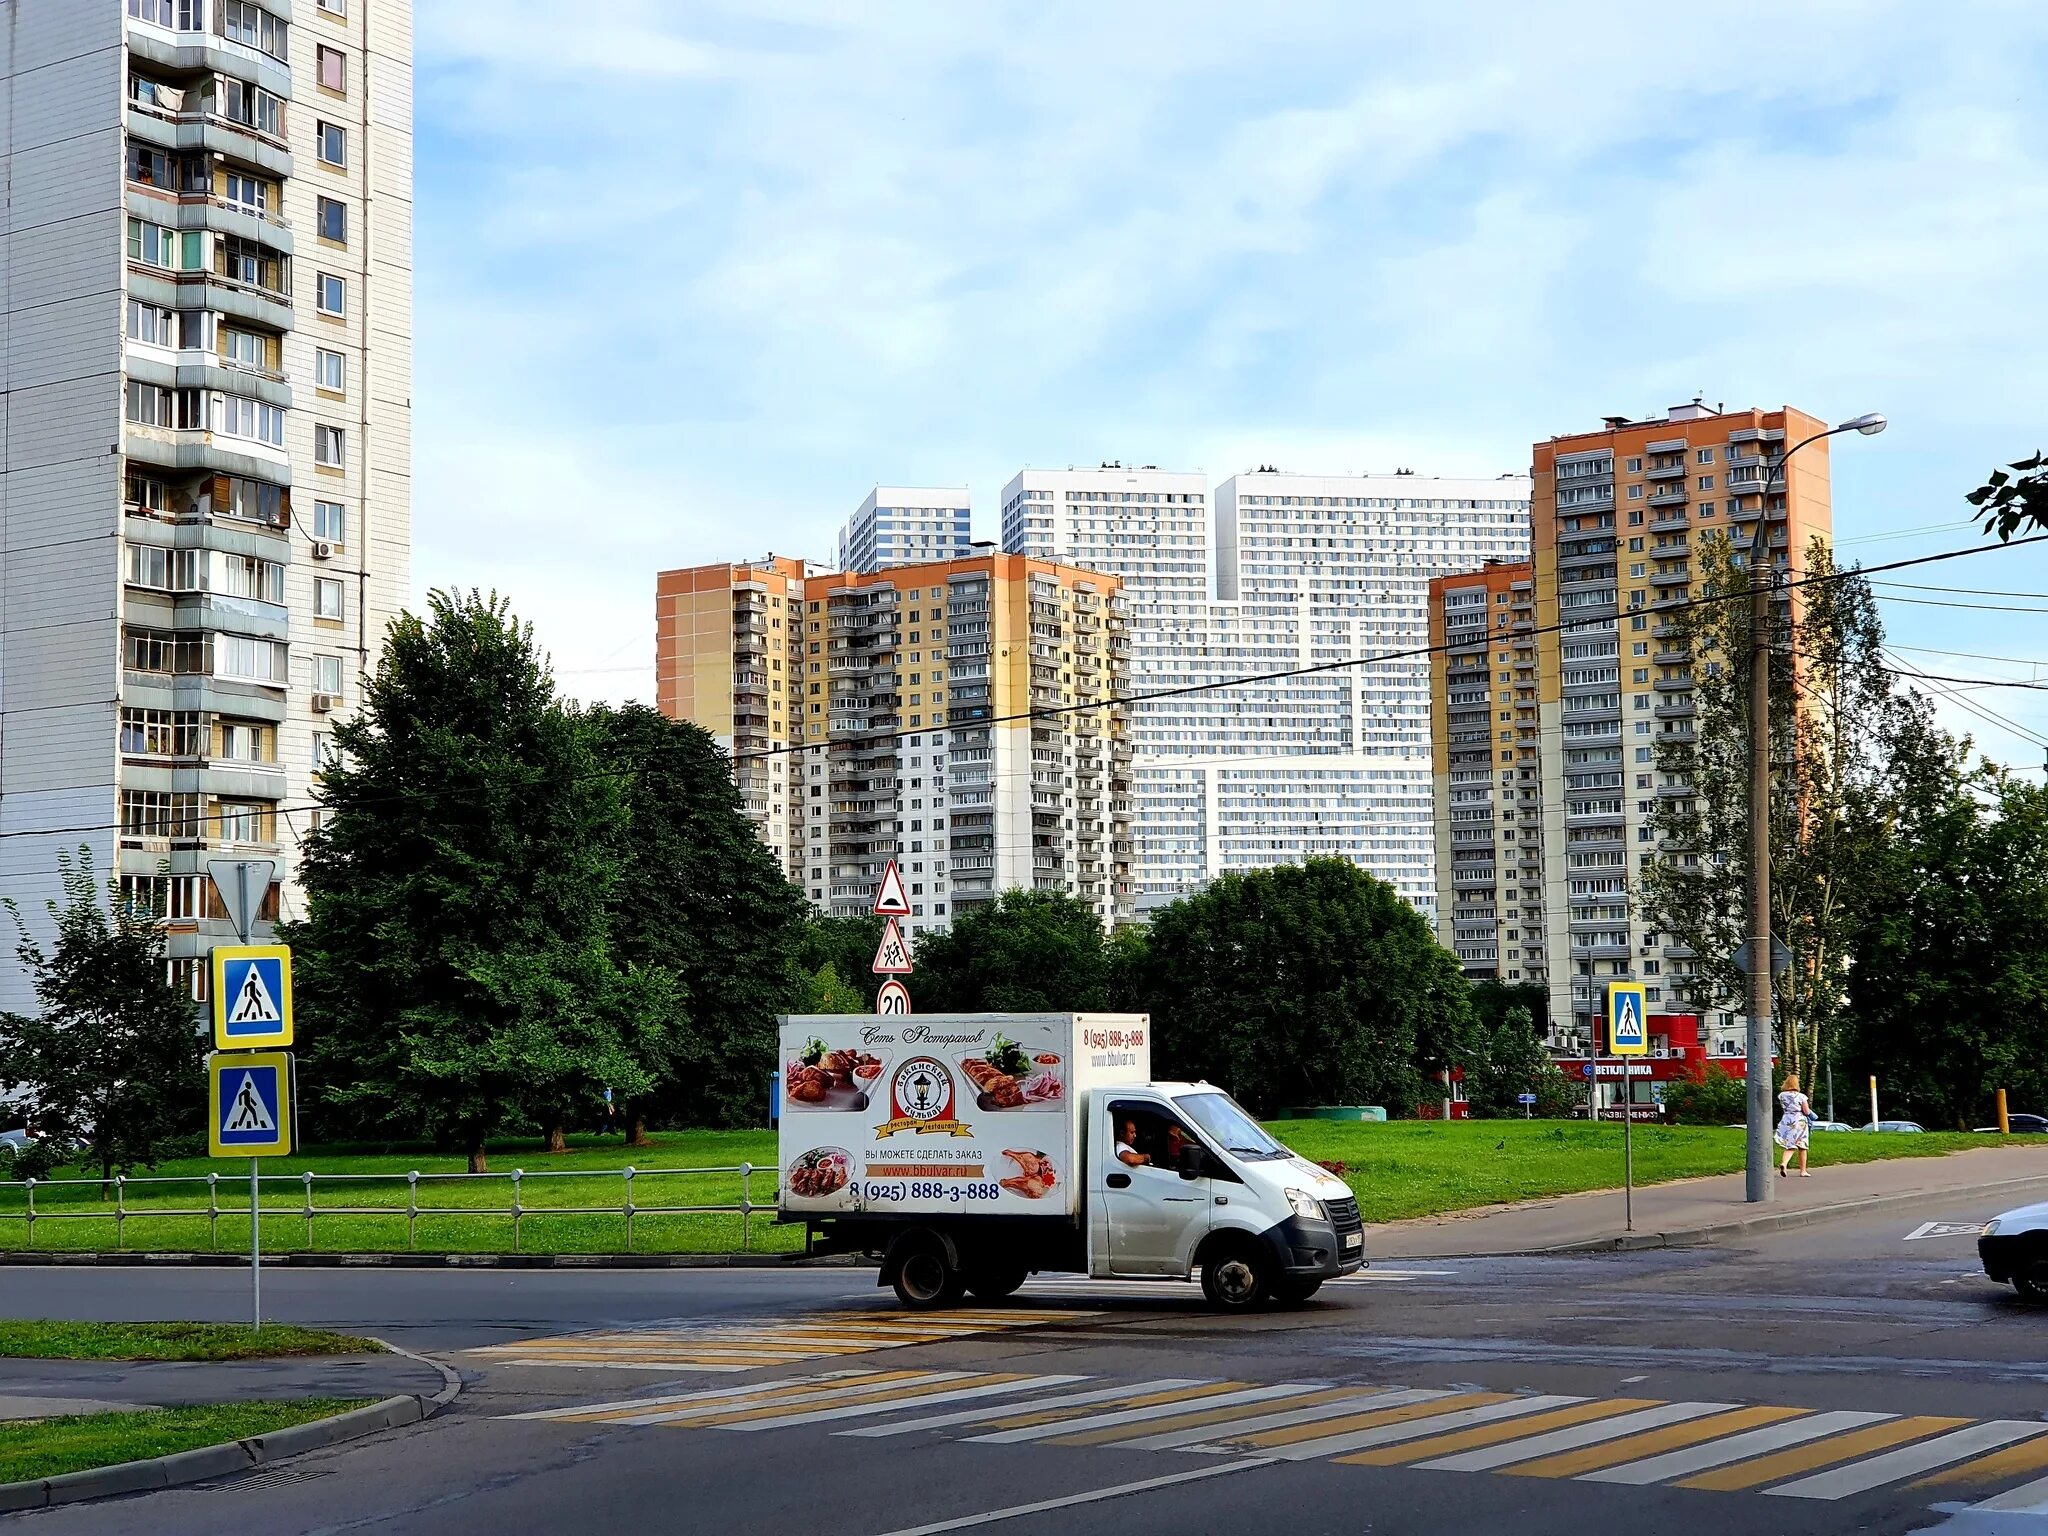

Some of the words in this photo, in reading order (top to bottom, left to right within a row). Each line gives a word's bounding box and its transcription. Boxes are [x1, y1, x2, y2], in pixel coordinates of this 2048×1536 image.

[883, 995, 905, 1015] 20
[859, 1026, 896, 1045] Сеть
[902, 1026, 986, 1049] Ресторанов
[1083, 1029, 1089, 1045] 8
[1090, 1029, 1107, 1049] (925)
[1109, 1030, 1144, 1049] 888-3-888
[1091, 1051, 1136, 1067] www.bbulvar.ru
[1595, 1065, 1653, 1075] ВЕТКЛНИКА
[925, 1122, 957, 1130] restaurant
[865, 1150, 877, 1159] ВЫ
[880, 1150, 914, 1159] МОЖЕТЕ
[917, 1150, 953, 1160] СДЕЛАТЬ
[955, 1150, 983, 1160] ЗАКАЗ
[883, 1165, 968, 1177] www.bbulvar.ru
[849, 1182, 860, 1197] 8
[865, 1181, 906, 1202] (925)
[911, 1182, 1000, 1203] 888-3-888
